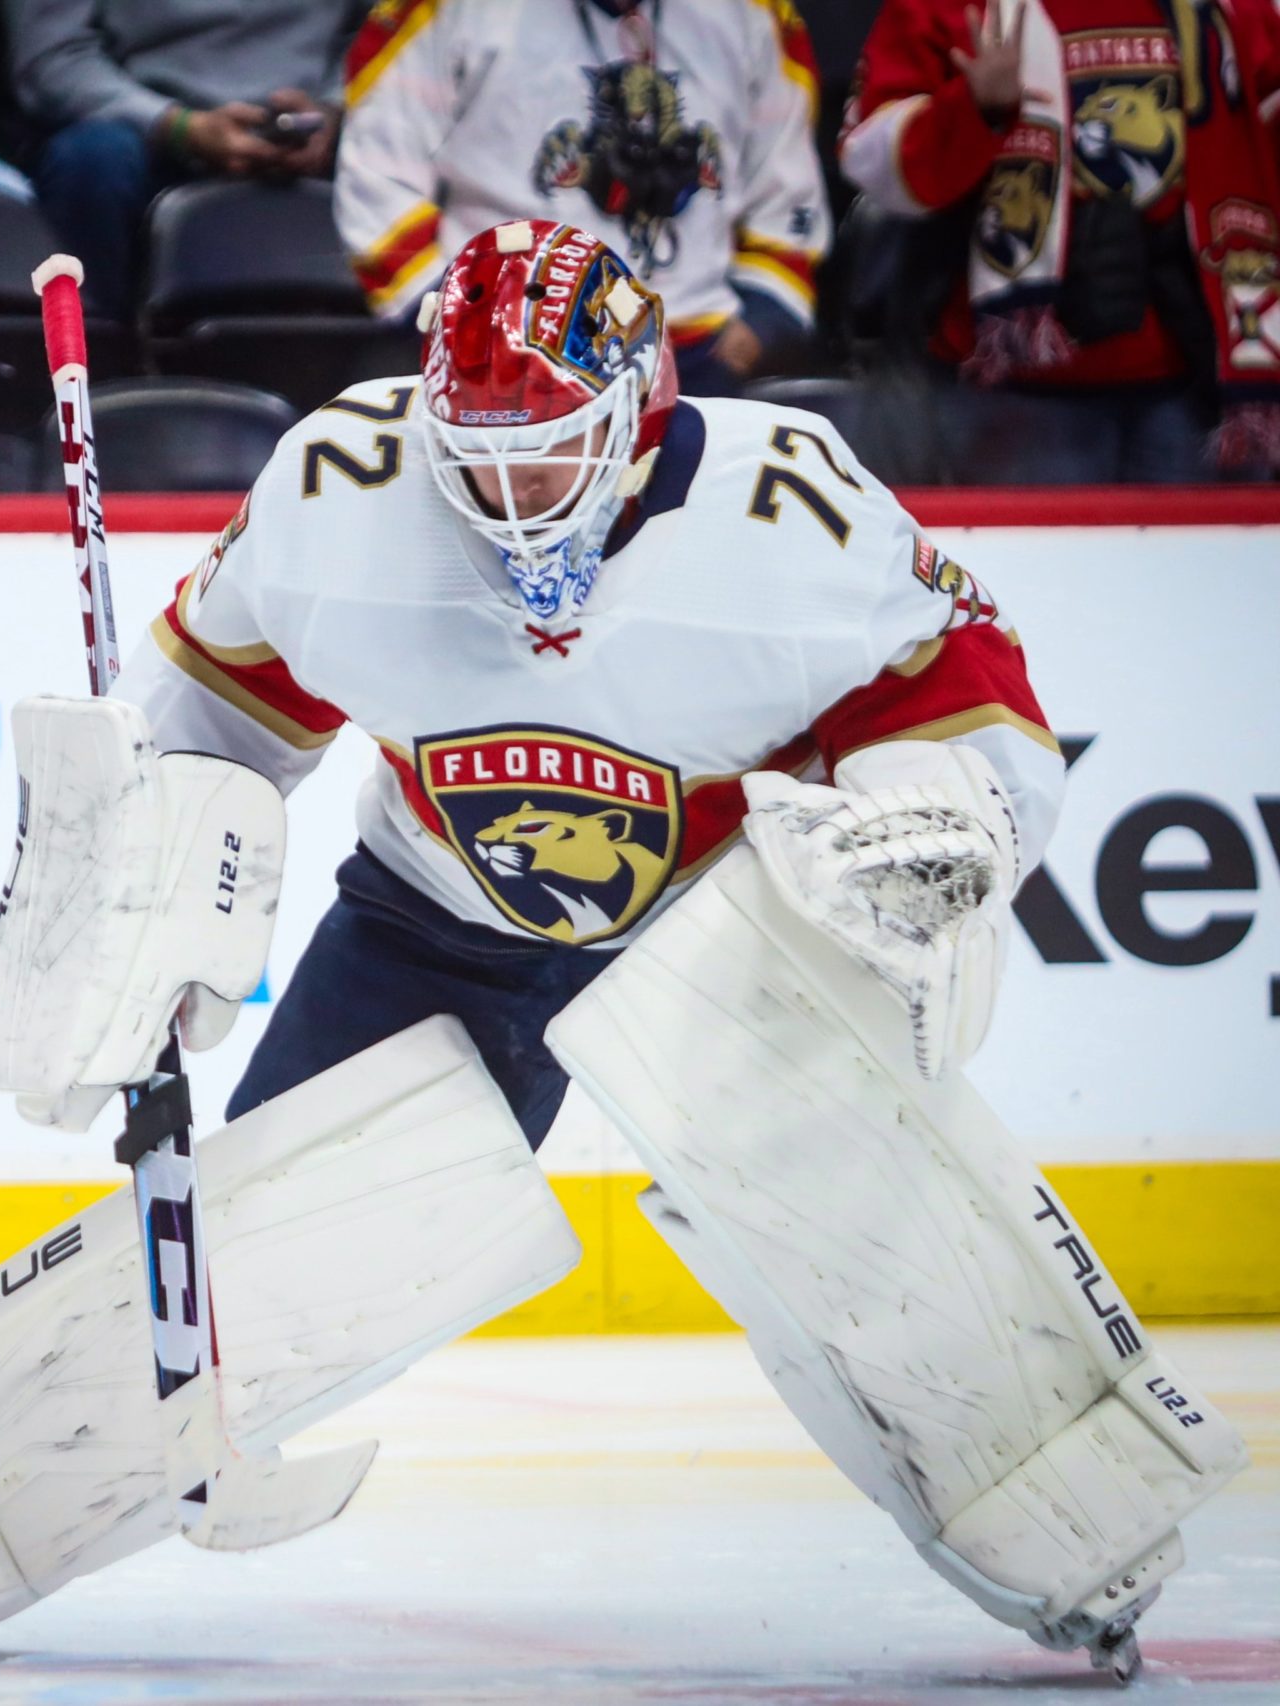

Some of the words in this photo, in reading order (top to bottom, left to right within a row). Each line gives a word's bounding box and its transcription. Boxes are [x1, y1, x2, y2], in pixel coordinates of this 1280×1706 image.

[458, 408, 532, 424] CCM
[746, 424, 865, 549] 72
[443, 746, 652, 801] FLORIDA
[215, 830, 242, 915] L12.2
[1032, 1184, 1143, 1359] TRUE
[1144, 1376, 1205, 1429] L12.2
